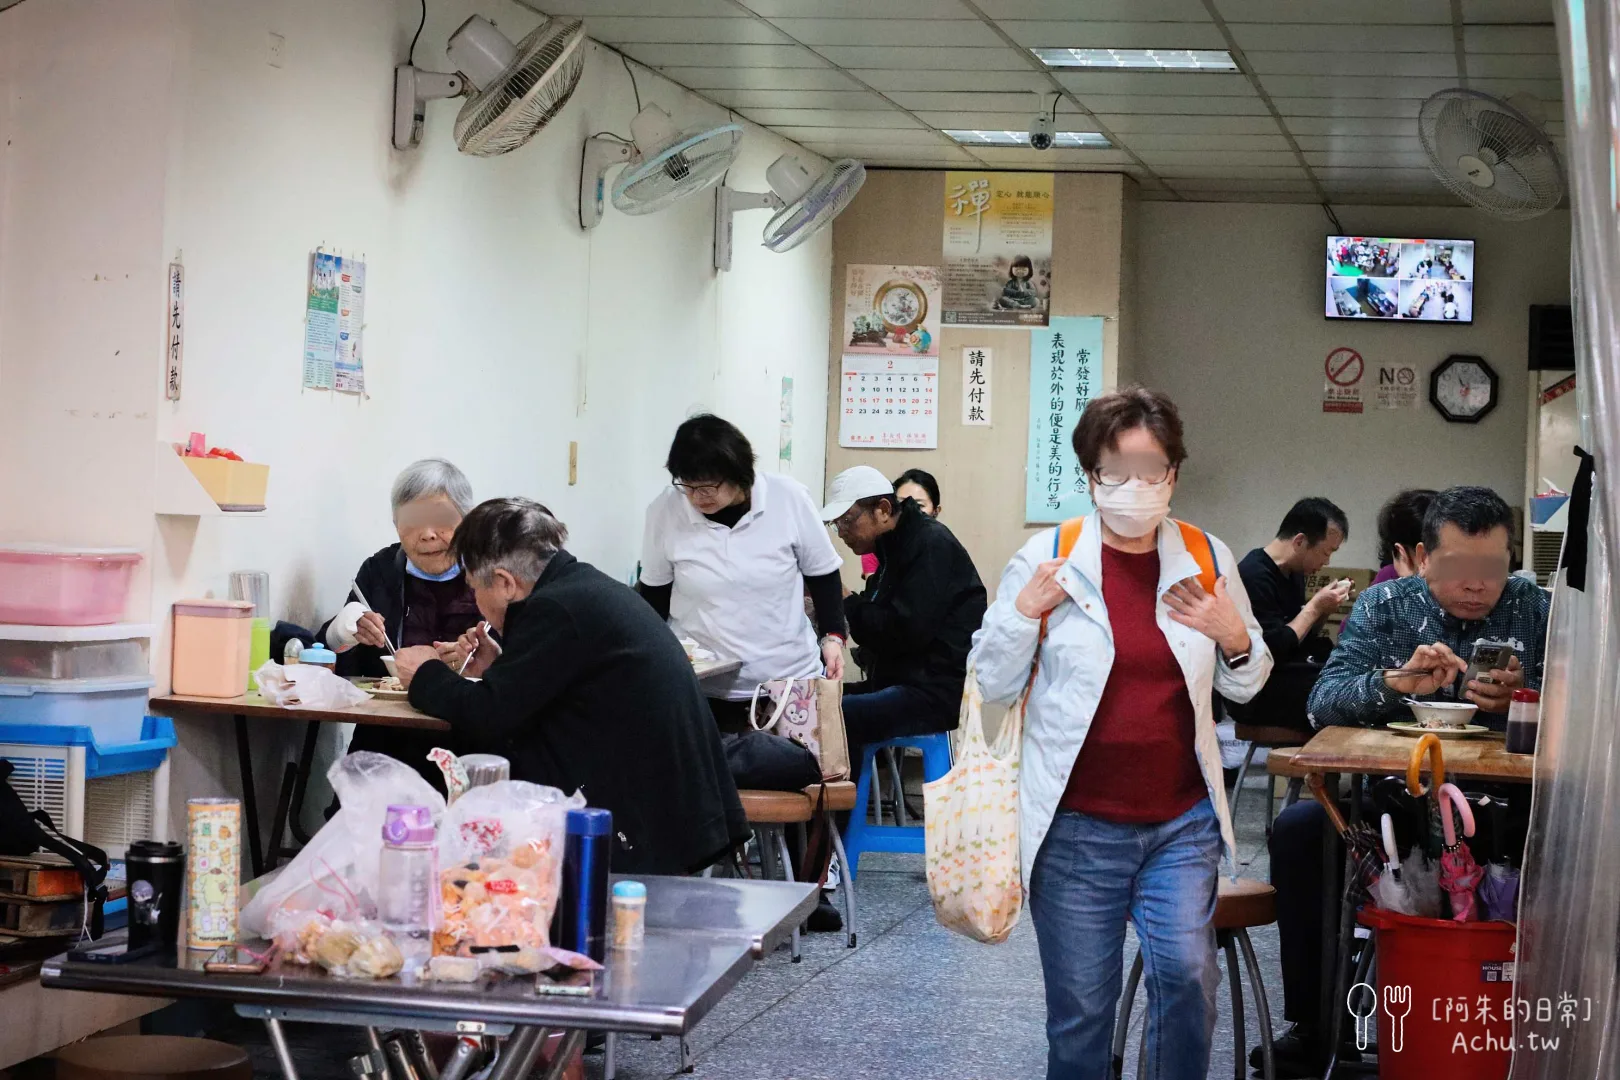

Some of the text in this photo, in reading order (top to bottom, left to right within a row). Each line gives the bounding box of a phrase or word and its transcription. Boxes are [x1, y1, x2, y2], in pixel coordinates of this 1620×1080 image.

[949, 178, 990, 254] 禪
[169, 271, 182, 393] 請先付款
[887, 360, 893, 369] 2
[968, 350, 985, 421] 請先付款
[1046, 332, 1065, 510] 表現於外的便是美的行為
